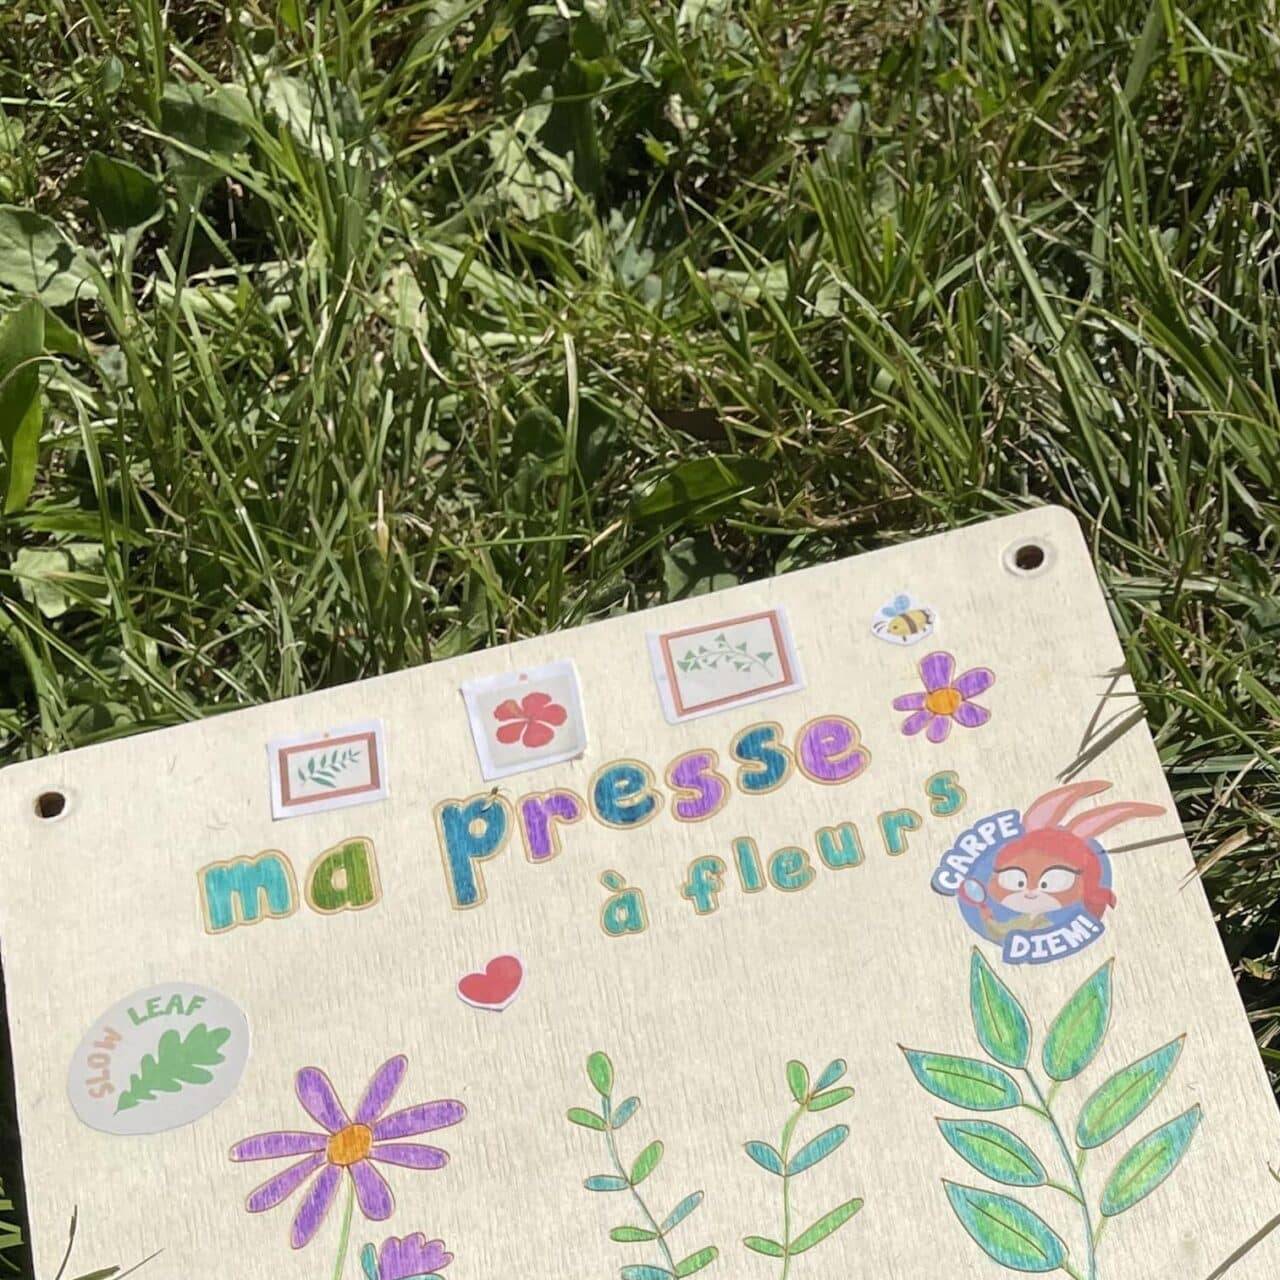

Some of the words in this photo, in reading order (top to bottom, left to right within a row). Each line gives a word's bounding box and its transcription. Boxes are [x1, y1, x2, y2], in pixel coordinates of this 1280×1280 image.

[197, 836, 382, 934] ma
[432, 715, 872, 910] presse
[600, 870, 648, 937] à
[681, 770, 967, 915] fleurs
[938, 814, 1019, 890] CARPE
[1009, 914, 1099, 959] DIEM!
[85, 1026, 122, 1098] SLOW
[127, 994, 207, 1026] LEAF
